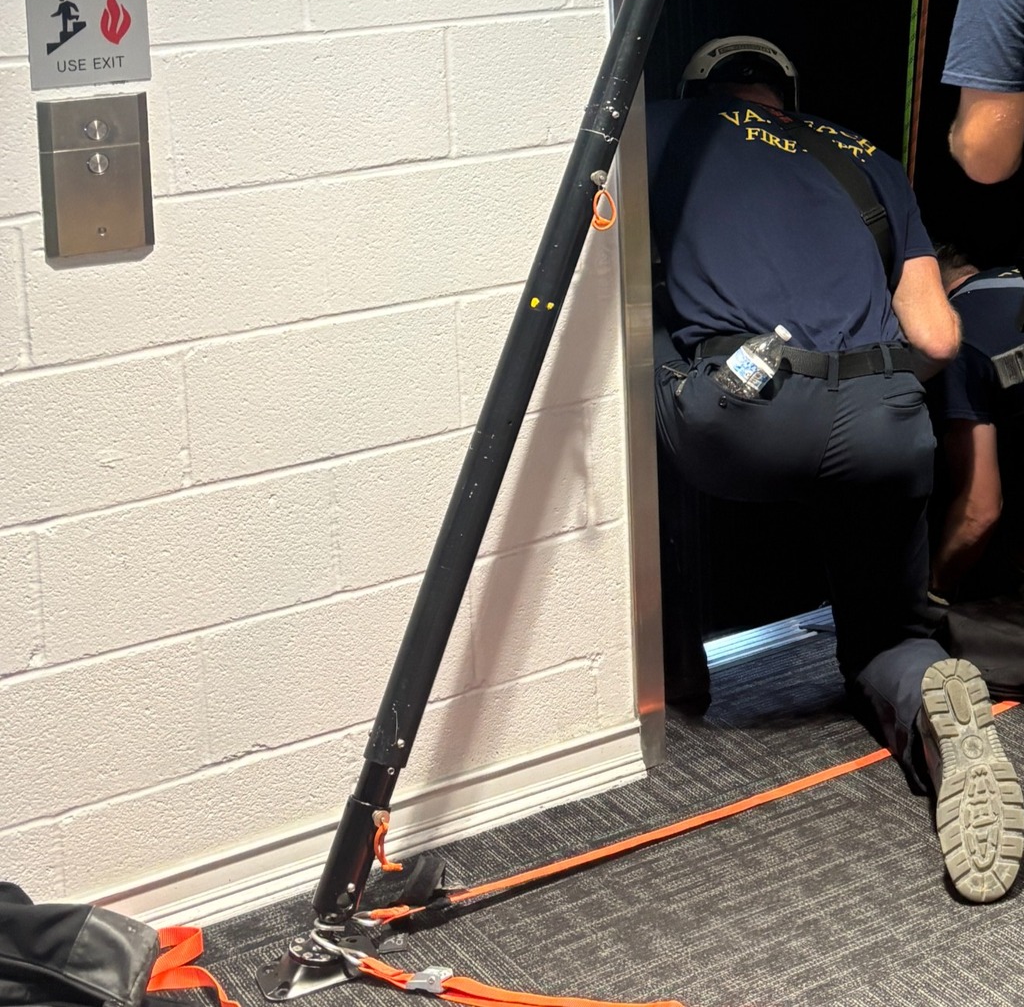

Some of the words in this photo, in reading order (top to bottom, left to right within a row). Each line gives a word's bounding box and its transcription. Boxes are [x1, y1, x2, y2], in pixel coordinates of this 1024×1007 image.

[56, 59, 87, 73] USE
[93, 55, 125, 70] EXIT
[745, 127, 797, 153] FIRE
